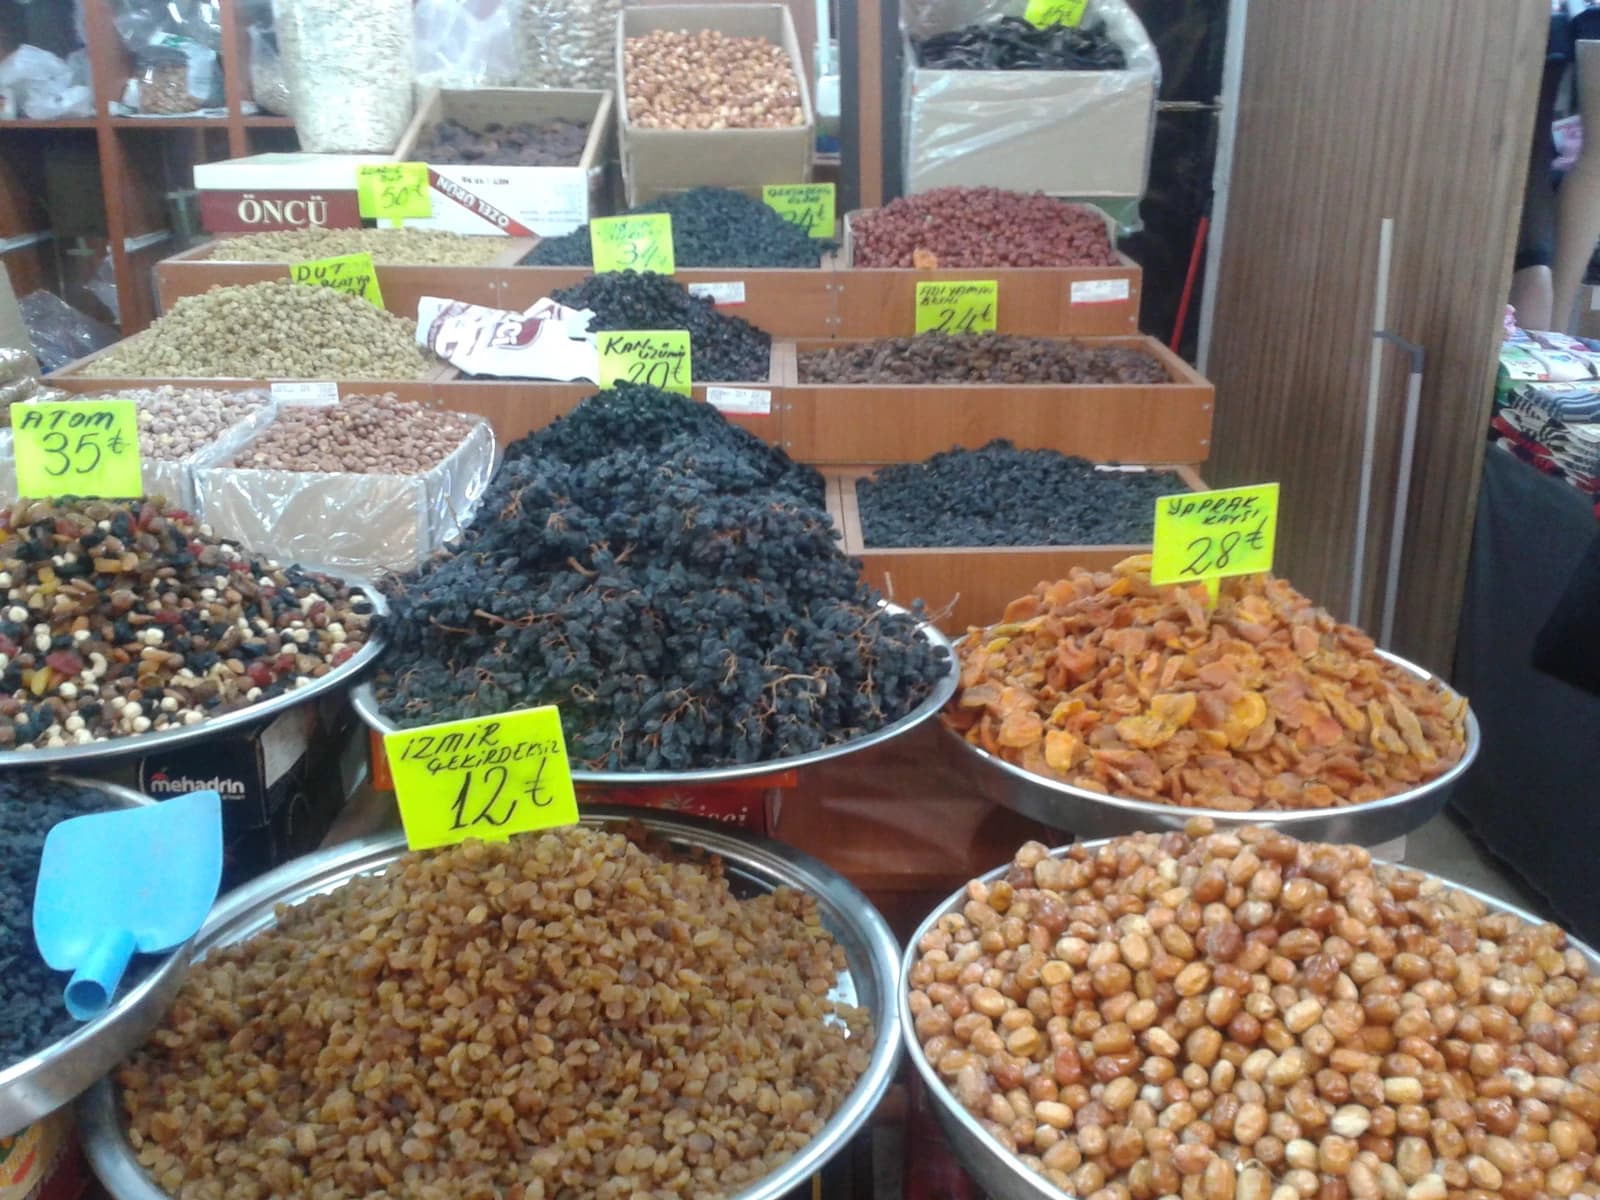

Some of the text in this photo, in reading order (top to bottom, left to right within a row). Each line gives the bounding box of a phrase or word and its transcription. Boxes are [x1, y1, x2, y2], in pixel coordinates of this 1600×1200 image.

[238, 193, 328, 225] ÖNCÜ
[297, 262, 345, 284] DUT
[1167, 496, 1259, 517] YAPRAK
[150, 776, 246, 794] mehadrin
